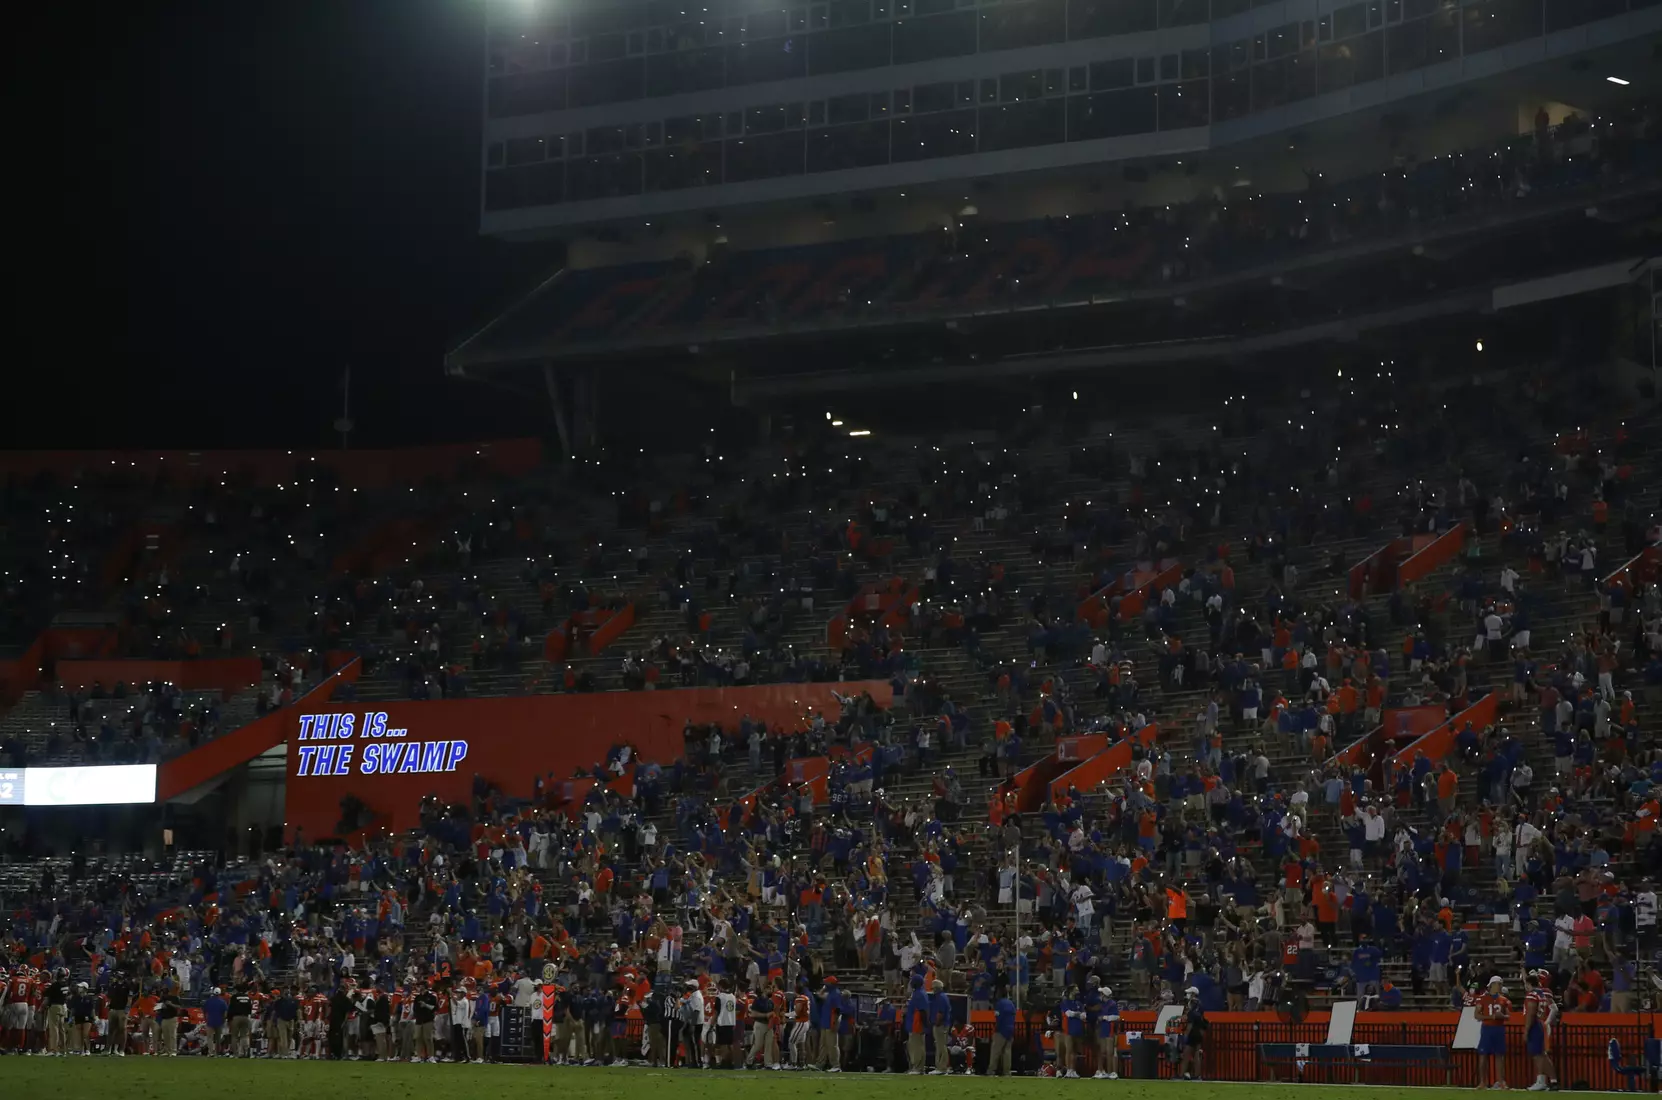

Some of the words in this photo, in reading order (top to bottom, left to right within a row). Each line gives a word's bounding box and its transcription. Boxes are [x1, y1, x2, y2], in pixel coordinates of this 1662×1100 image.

[298, 712, 356, 741] THIS
[360, 711, 408, 738] IS...
[296, 744, 355, 776] THE
[359, 740, 469, 774] SWAMP
[1287, 944, 1298, 955] 22
[18, 982, 26, 996] 8
